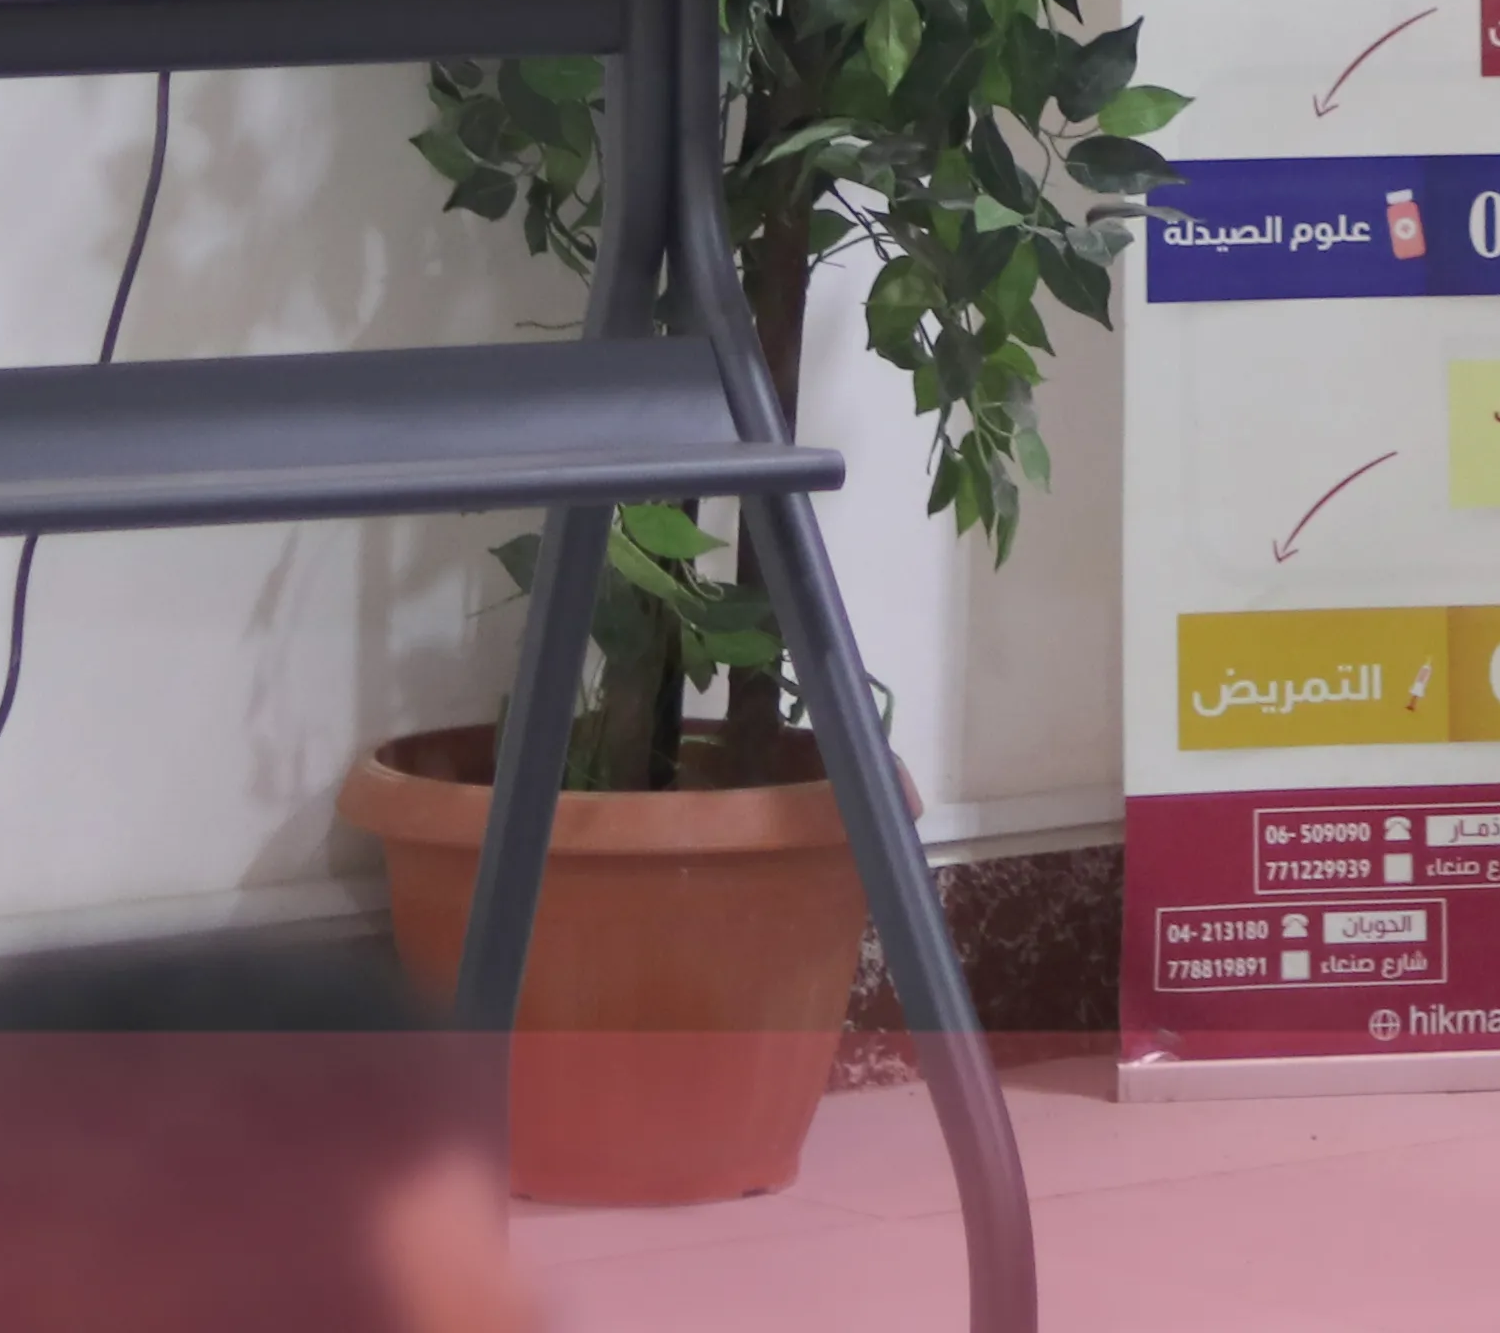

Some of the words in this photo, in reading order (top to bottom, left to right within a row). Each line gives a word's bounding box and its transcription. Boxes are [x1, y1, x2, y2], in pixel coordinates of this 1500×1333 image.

[1162, 214, 1284, 254] الصيدلة
[1289, 214, 1372, 252] علوم
[1191, 664, 1382, 719] التمريض
[1301, 821, 1371, 844] 509090
[1265, 858, 1371, 882] 771229939
[1426, 855, 1480, 878] صنعاء
[1201, 919, 1269, 942] 213180
[1320, 954, 1376, 975] صنعاء
[1380, 950, 1429, 980] شارع
